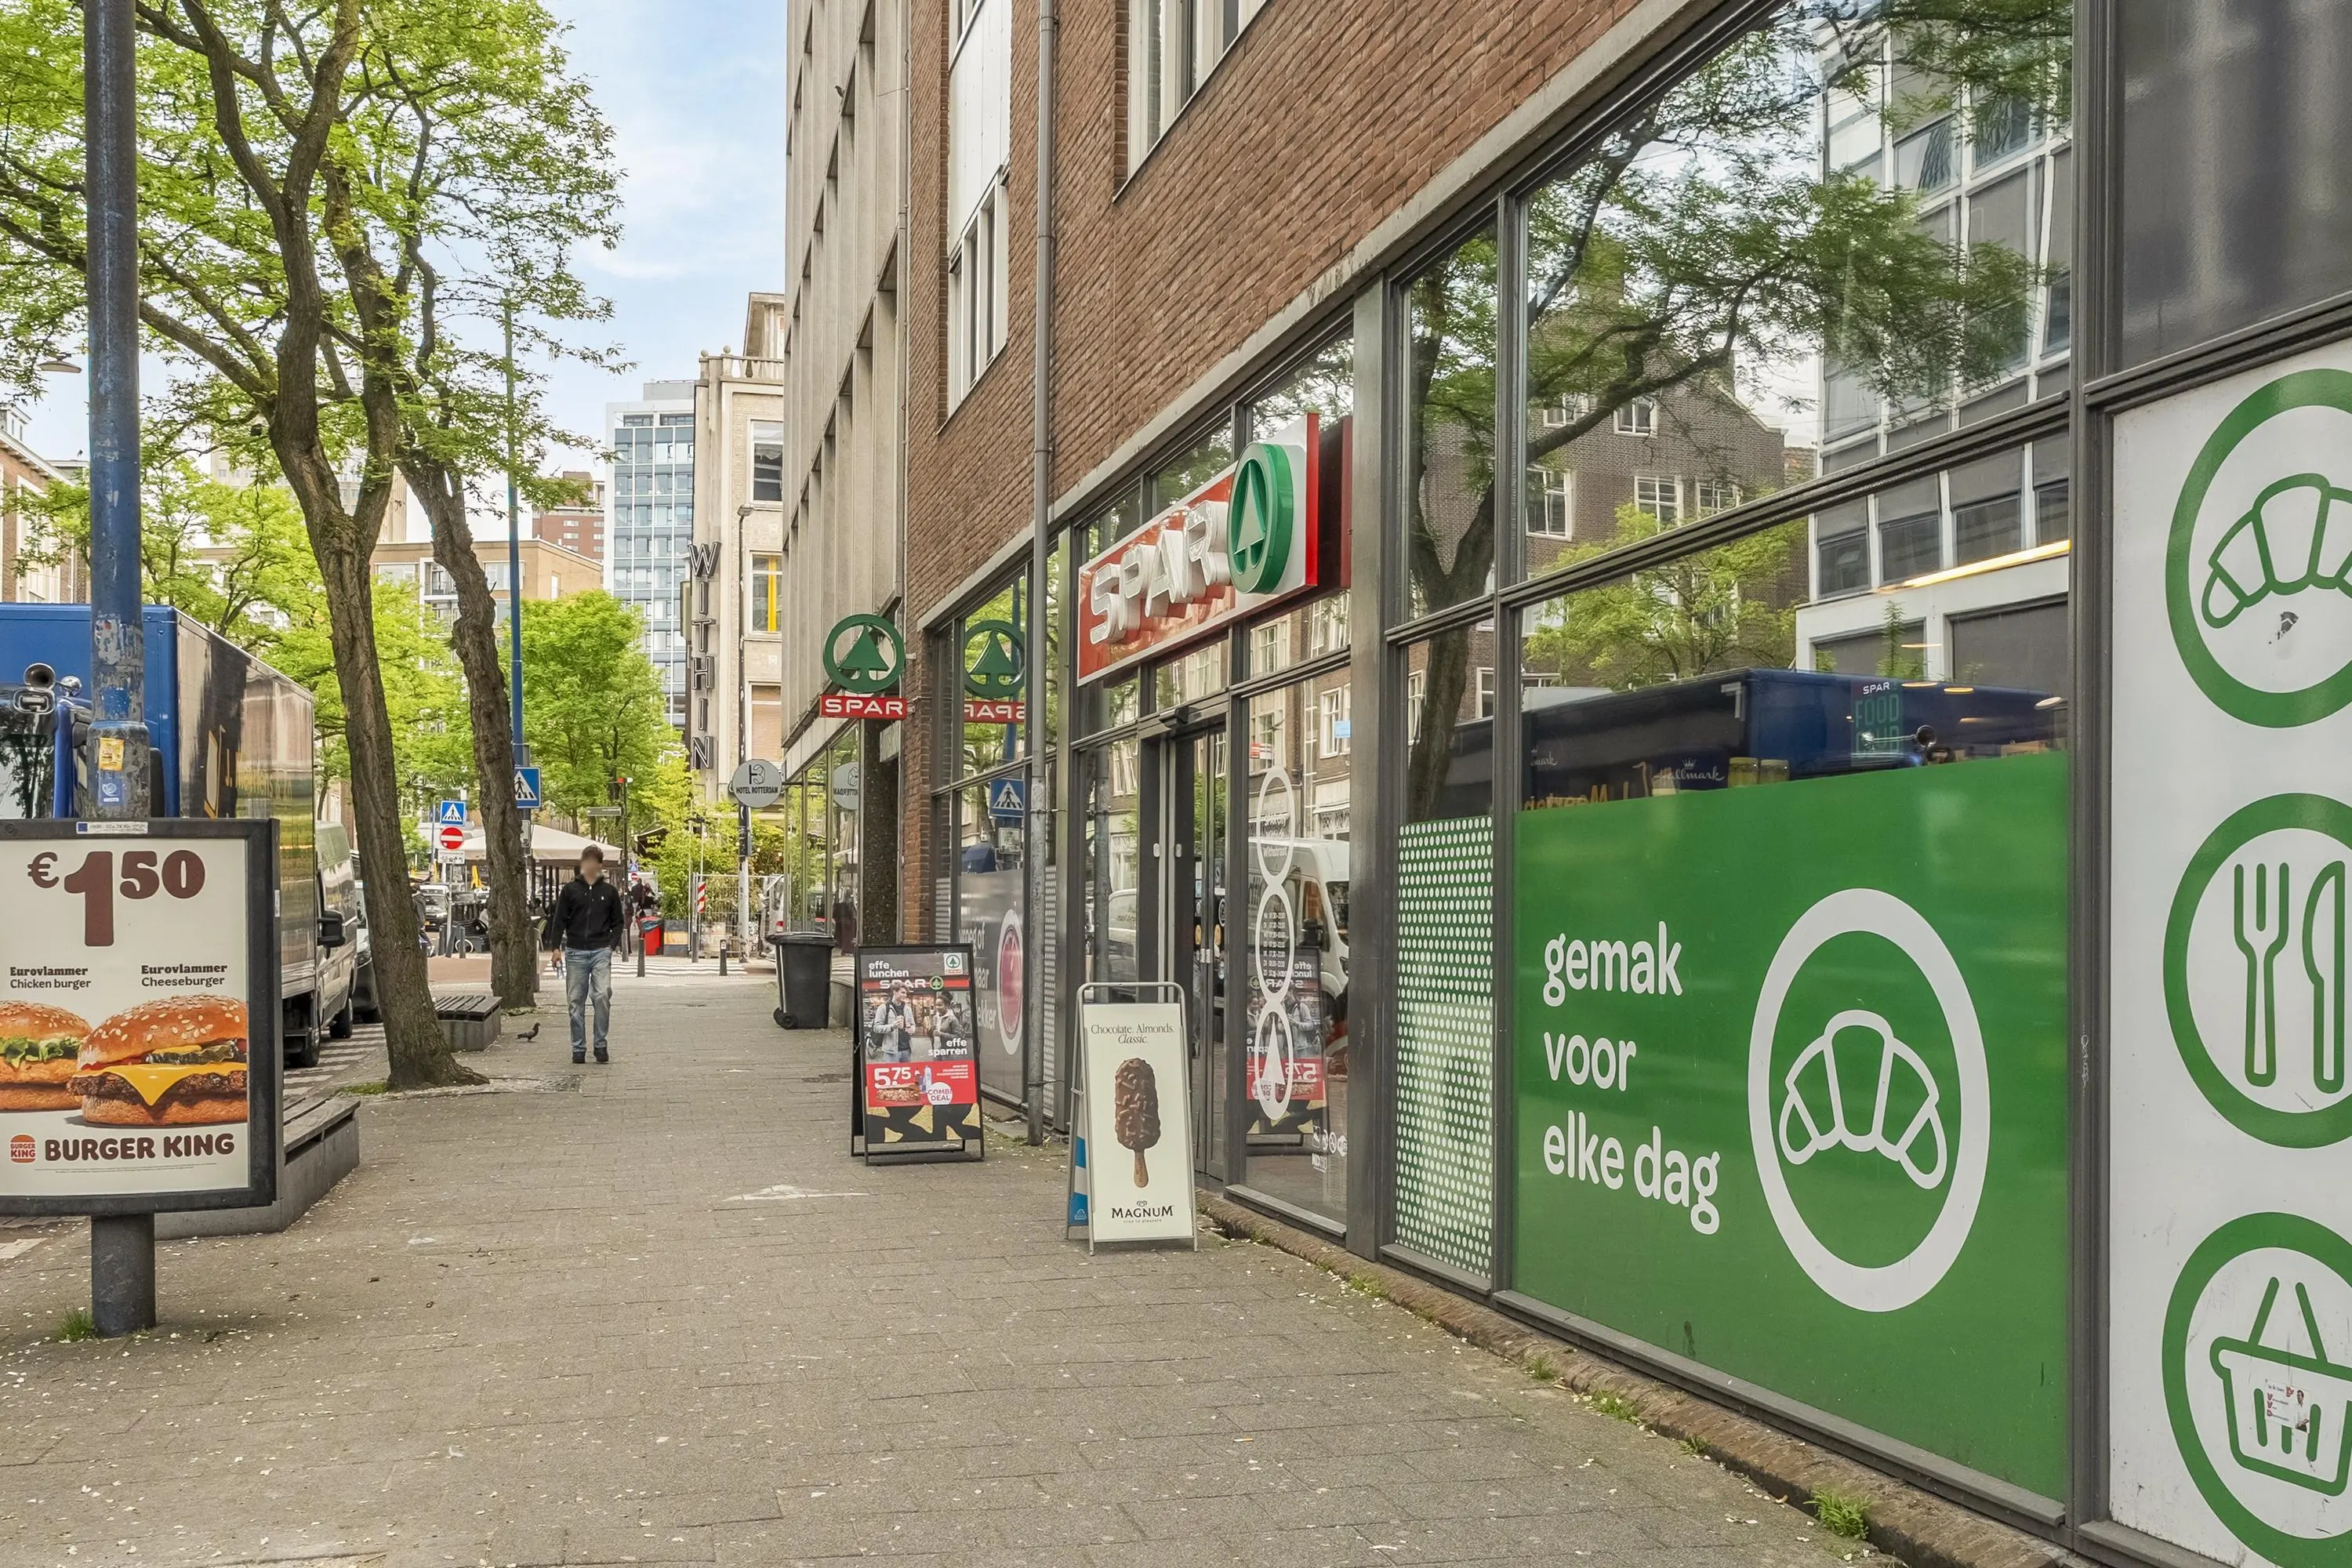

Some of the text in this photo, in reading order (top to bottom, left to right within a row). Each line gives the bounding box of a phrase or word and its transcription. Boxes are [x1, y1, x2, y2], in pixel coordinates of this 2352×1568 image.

[1090, 500, 1231, 644] SPAR
[688, 542, 721, 769] WITHIN
[1863, 681, 1890, 695] SPAR
[826, 699, 903, 715] SPAR
[1652, 766, 1725, 786] Hallmark
[141, 964, 227, 975] Eurovlammer
[869, 960, 890, 970] effe
[1543, 920, 1682, 1007] gemak
[9, 966, 89, 976] Eurovlammer
[869, 969, 909, 978] lunchen
[10, 978, 92, 991] Chicken burger
[142, 976, 225, 987] Cheeseburger
[946, 1038, 967, 1047] effe
[928, 1047, 967, 1057] sparren
[1543, 1032, 1636, 1091] voor
[10, 1149, 36, 1158] KING
[45, 1133, 235, 1161] BURGER KING
[1543, 1110, 1720, 1235] elke dag
[1112, 1205, 1174, 1218] MAGNUM
